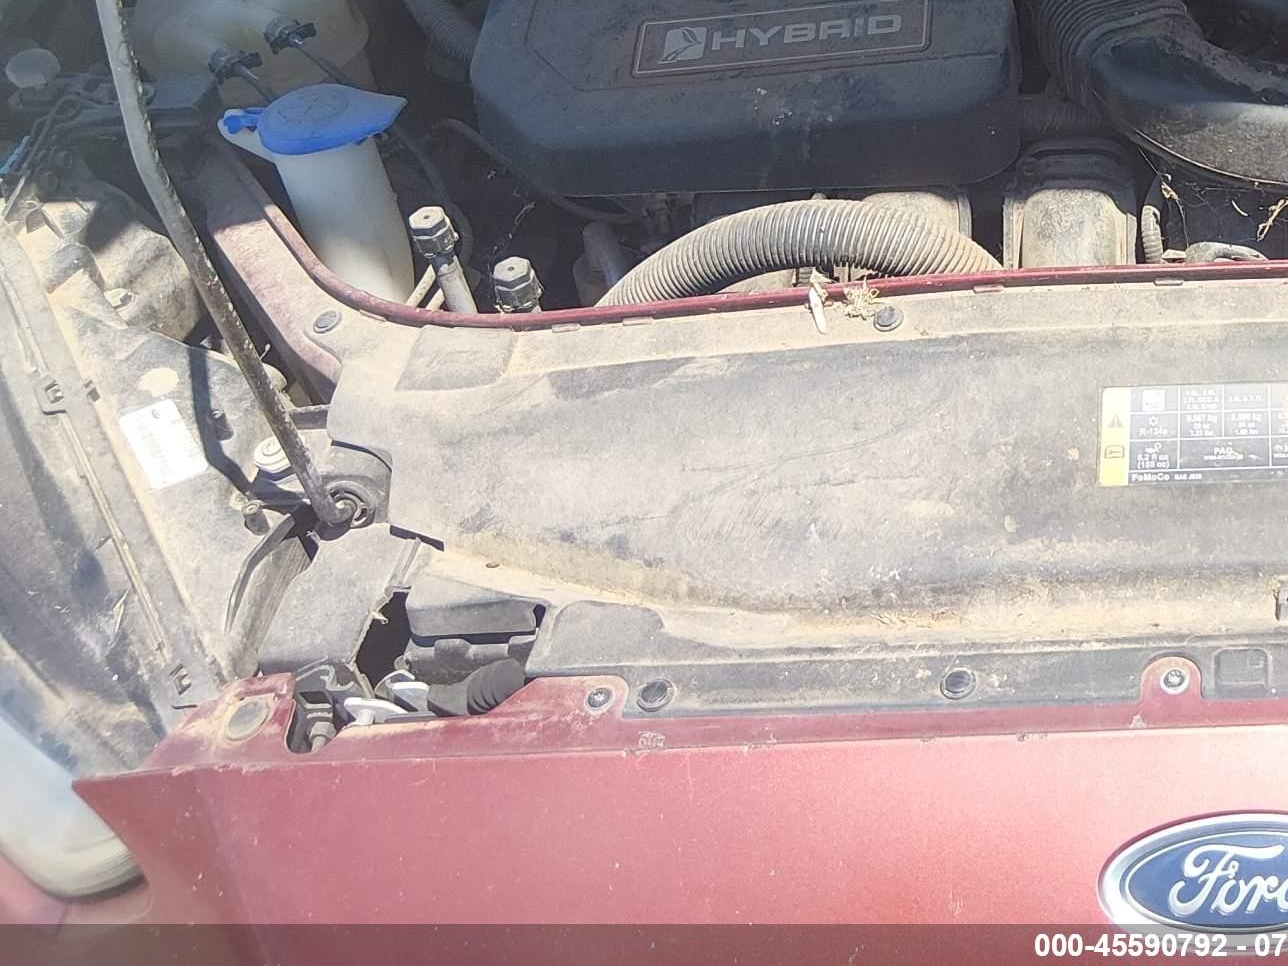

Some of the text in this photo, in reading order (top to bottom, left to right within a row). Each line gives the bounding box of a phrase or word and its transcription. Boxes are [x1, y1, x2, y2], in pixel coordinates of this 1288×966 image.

[711, 14, 901, 51] HYBRID
[1139, 427, 1168, 436] R-134a
[1131, 473, 1170, 482] FoMoCo
